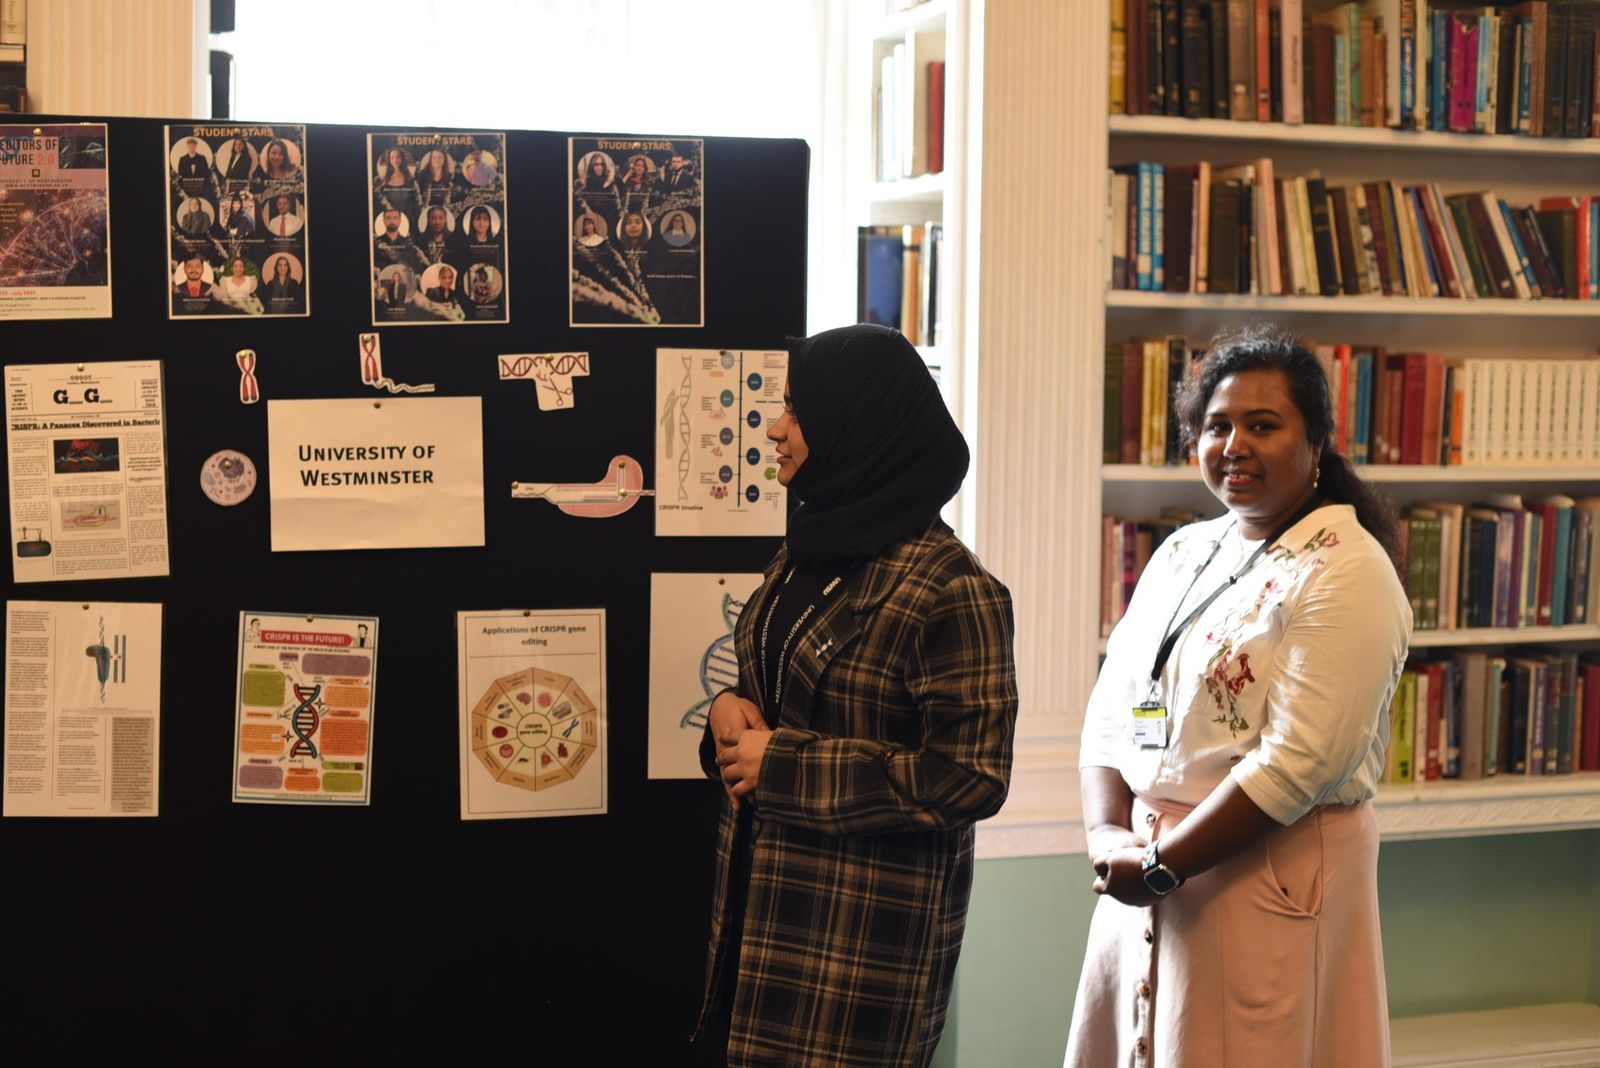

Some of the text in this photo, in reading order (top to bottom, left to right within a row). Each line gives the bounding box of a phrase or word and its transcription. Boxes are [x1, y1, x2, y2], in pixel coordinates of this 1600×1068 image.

[194, 128, 274, 137] STUDEN STARS
[45, 138, 57, 150] OF
[397, 136, 472, 146] STUDEN STARS
[598, 142, 672, 151] STUDEN STARS
[82, 420, 121, 428] Discovered
[298, 445, 436, 462] UNIVERSITY OF
[300, 470, 434, 487] WESTMINSTER
[761, 595, 780, 648] WESTMINSTER
[788, 604, 816, 642] UNIVERSITY
[482, 626, 528, 635] Applications
[264, 632, 291, 640] CRISPR
[292, 633, 300, 641] IS
[301, 633, 314, 642] THE
[521, 638, 548, 646] editing
